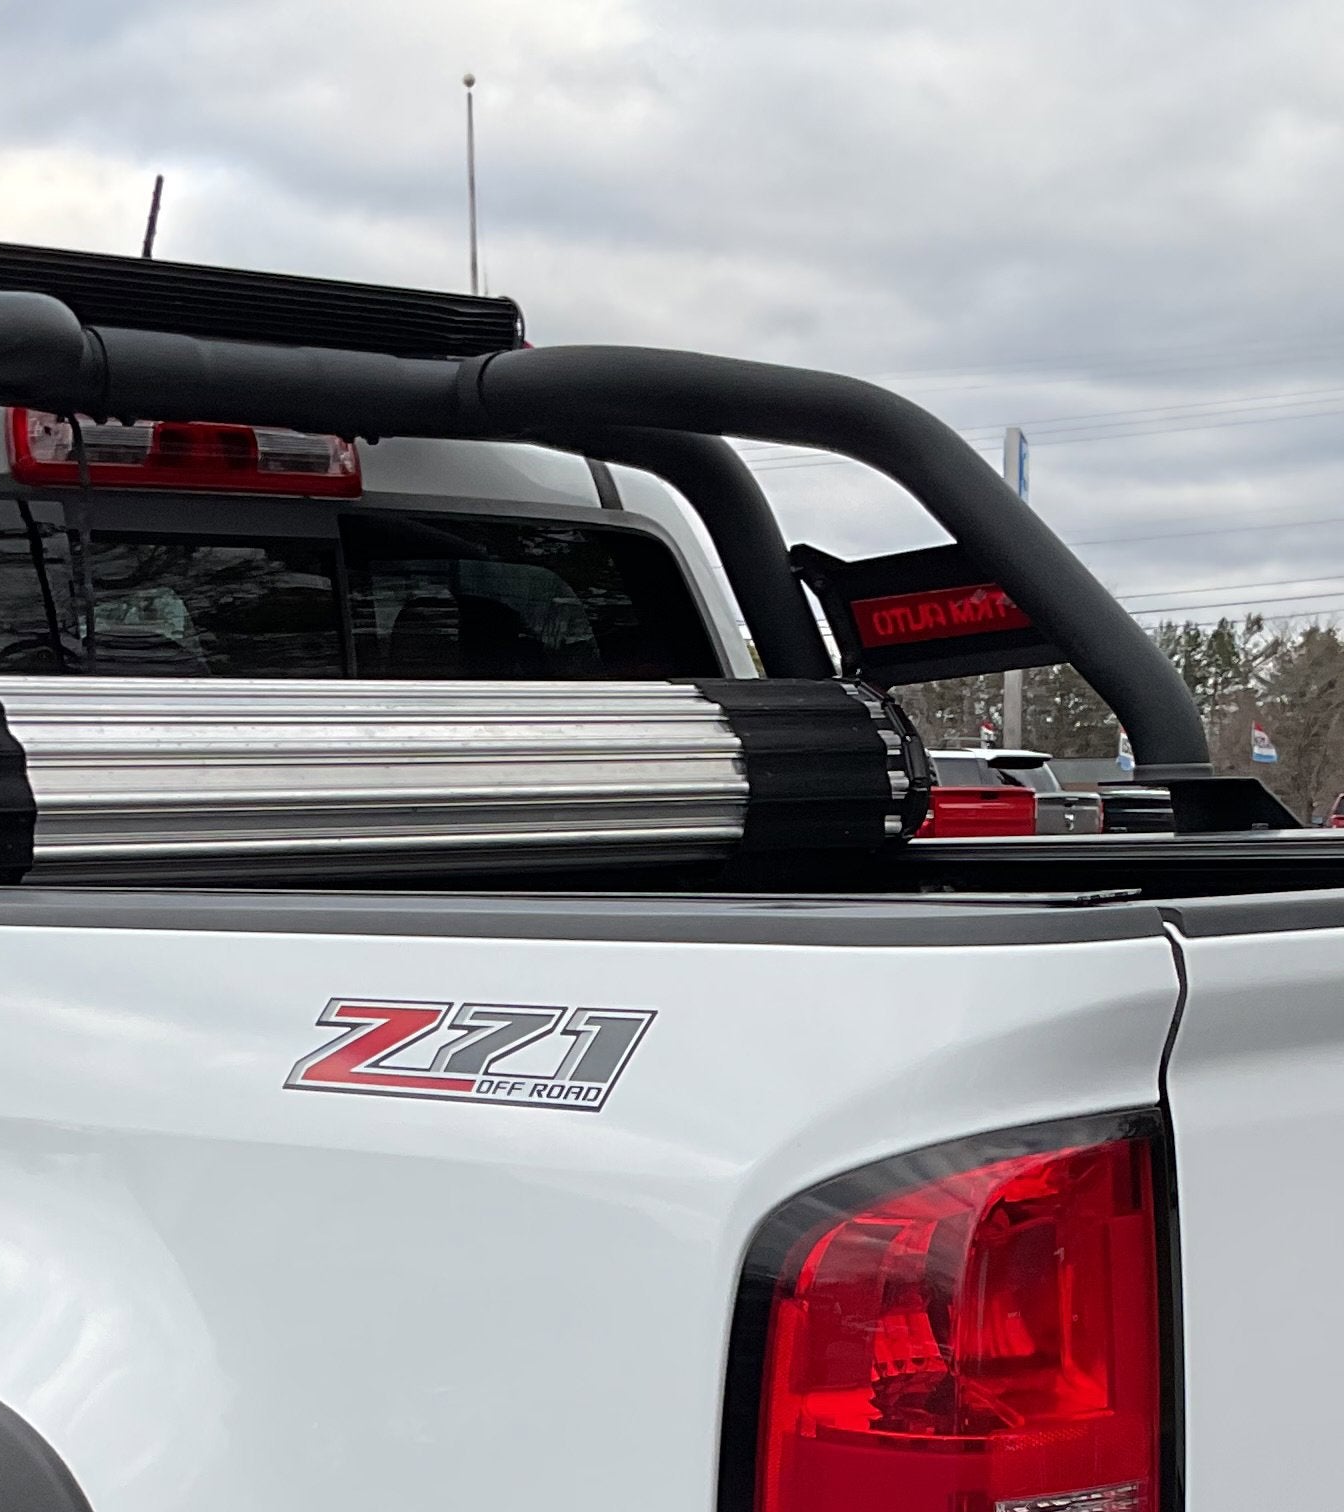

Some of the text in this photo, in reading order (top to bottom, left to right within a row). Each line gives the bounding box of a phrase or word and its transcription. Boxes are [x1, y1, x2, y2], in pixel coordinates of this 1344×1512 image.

[282, 997, 658, 1113] Z71
[476, 1079, 604, 1102] OFF ROAD
